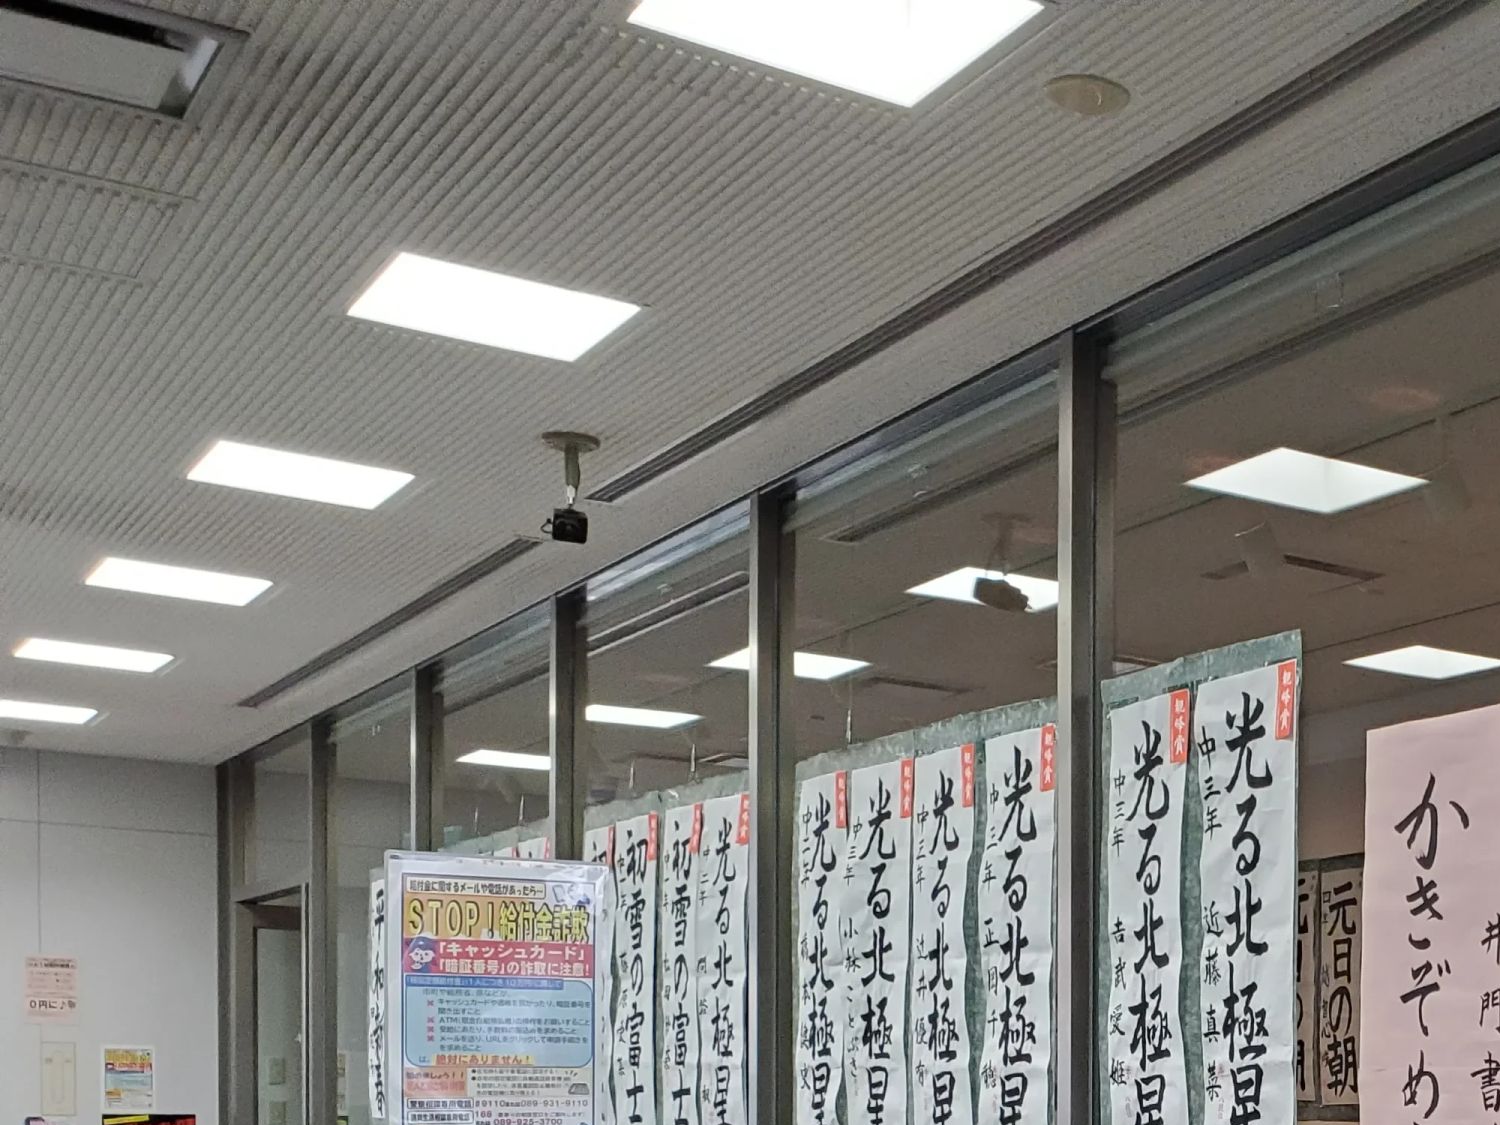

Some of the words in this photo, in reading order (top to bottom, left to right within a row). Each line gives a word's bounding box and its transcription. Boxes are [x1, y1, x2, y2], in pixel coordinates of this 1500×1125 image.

[1196, 724, 1224, 840] 中三年
[439, 941, 586, 962] 「キャッシュカード」
[626, 830, 648, 1124] 初雪の富士
[1327, 881, 1358, 1097] 元日の朝
